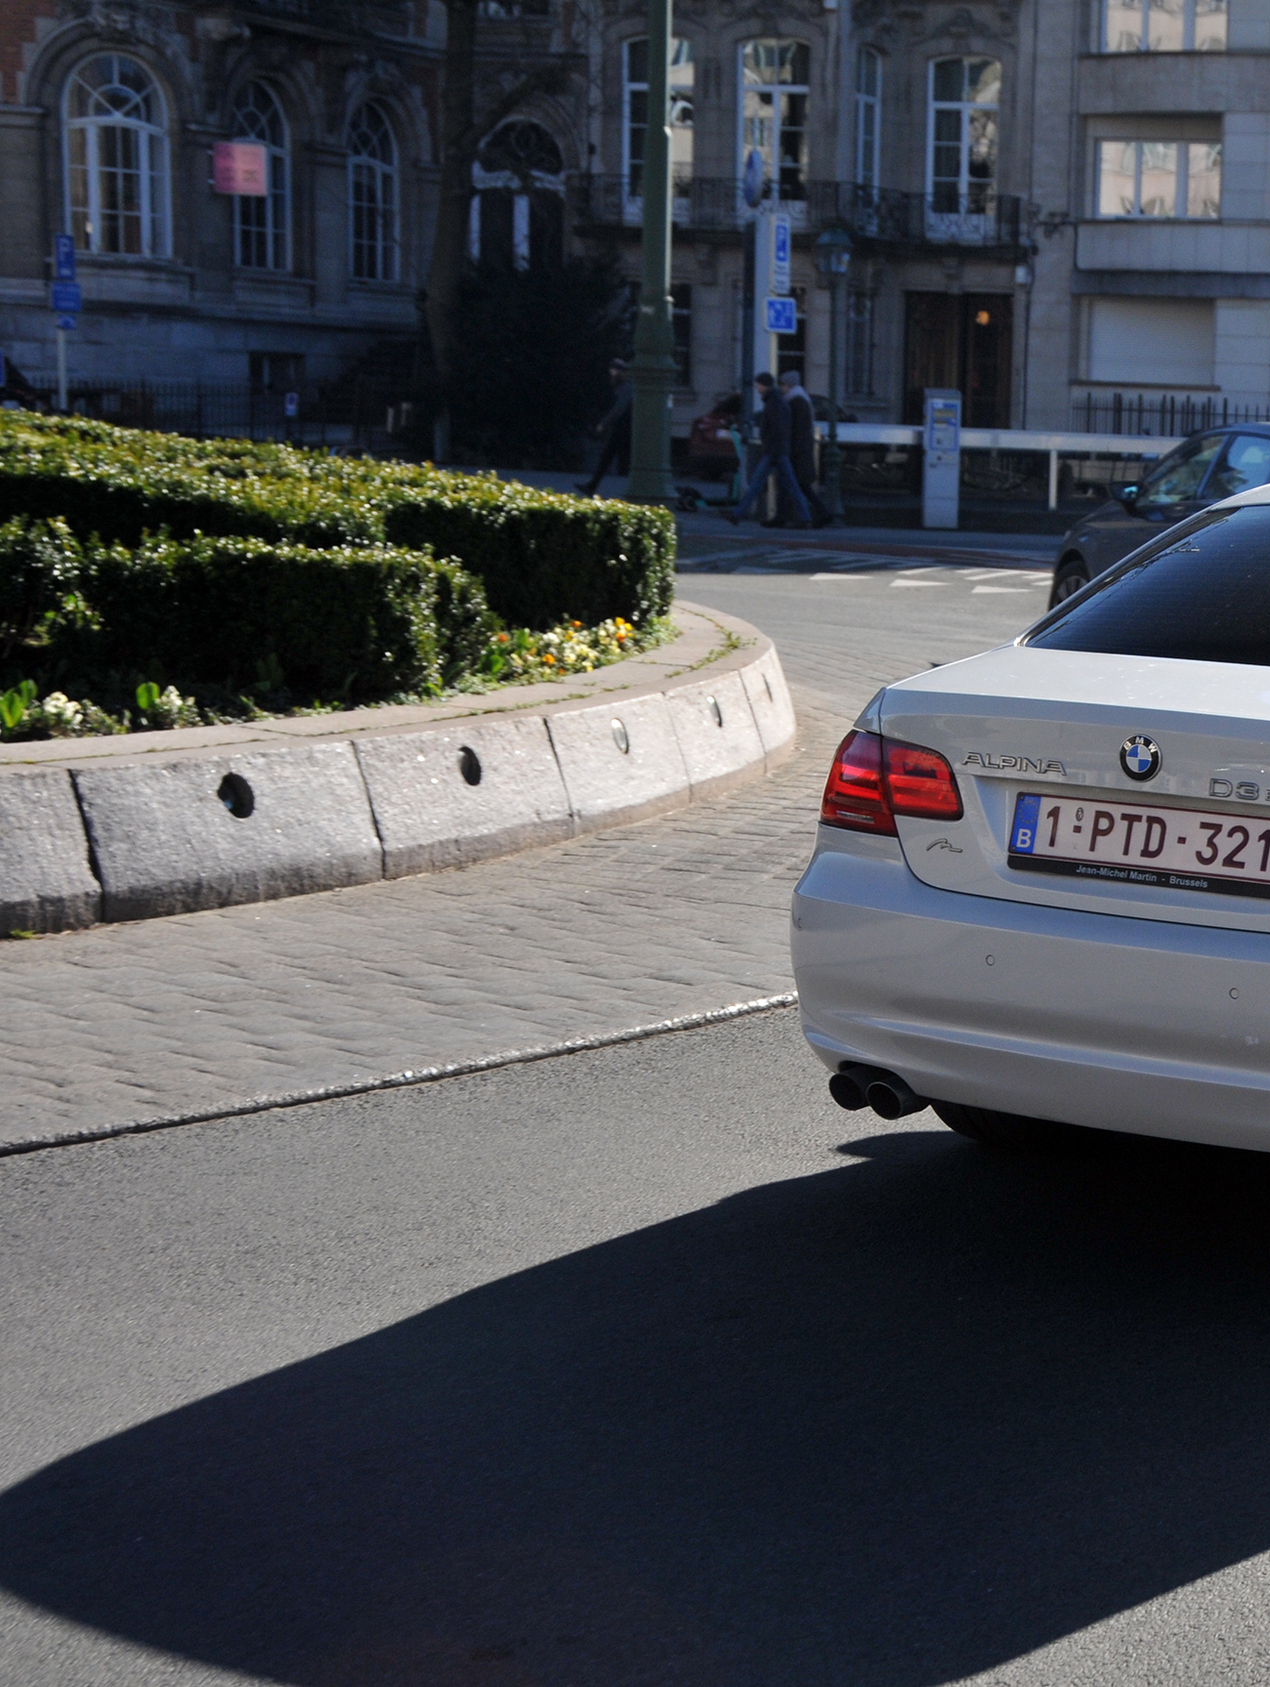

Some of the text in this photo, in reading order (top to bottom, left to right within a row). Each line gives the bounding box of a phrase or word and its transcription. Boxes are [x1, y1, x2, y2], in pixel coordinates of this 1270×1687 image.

[1123, 736, 1158, 753] BMW
[962, 751, 1067, 776] ALPINA
[1208, 777, 1260, 801] D3
[1016, 828, 1032, 848] B
[1075, 864, 1128, 879] Jean-Michel
[1129, 871, 1157, 882] Martin
[1169, 875, 1208, 888] Brussels
